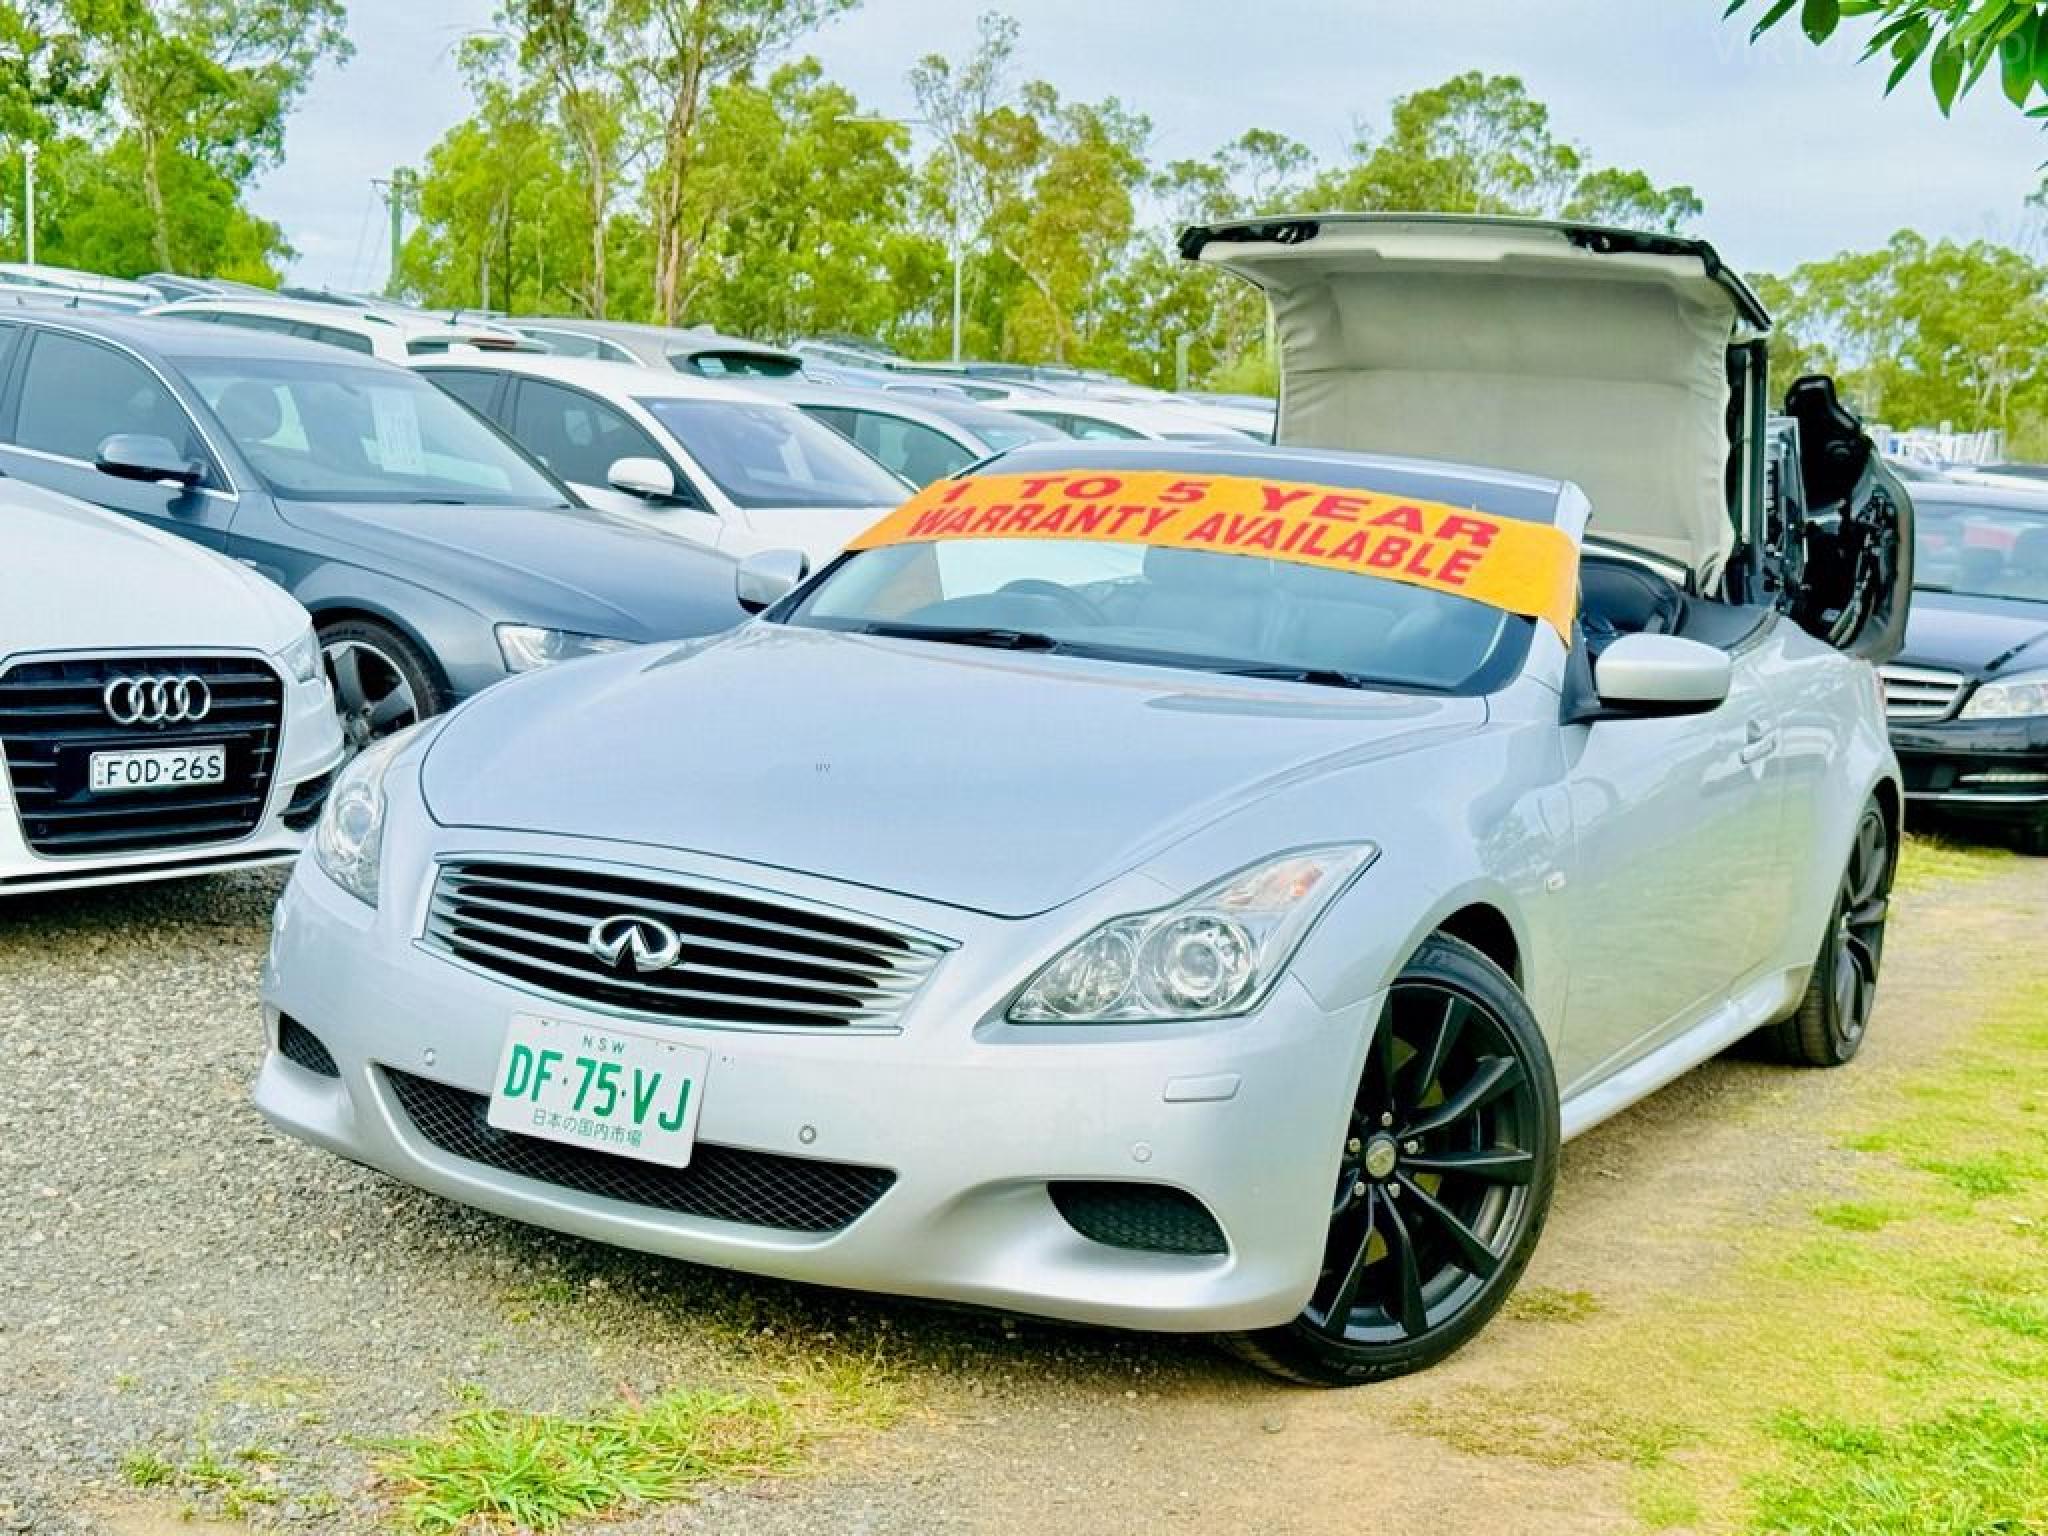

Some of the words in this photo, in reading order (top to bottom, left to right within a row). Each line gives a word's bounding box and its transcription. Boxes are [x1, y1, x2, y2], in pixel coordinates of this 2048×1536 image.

[907, 503, 1181, 537] WARRANTY
[1184, 511, 1483, 585] AVAILABLE
[943, 481, 973, 502] 1
[1019, 477, 1123, 499] TO
[1157, 481, 1213, 503] 5
[1261, 485, 1500, 548] YEAR
[582, 1034, 625, 1053] NSW
